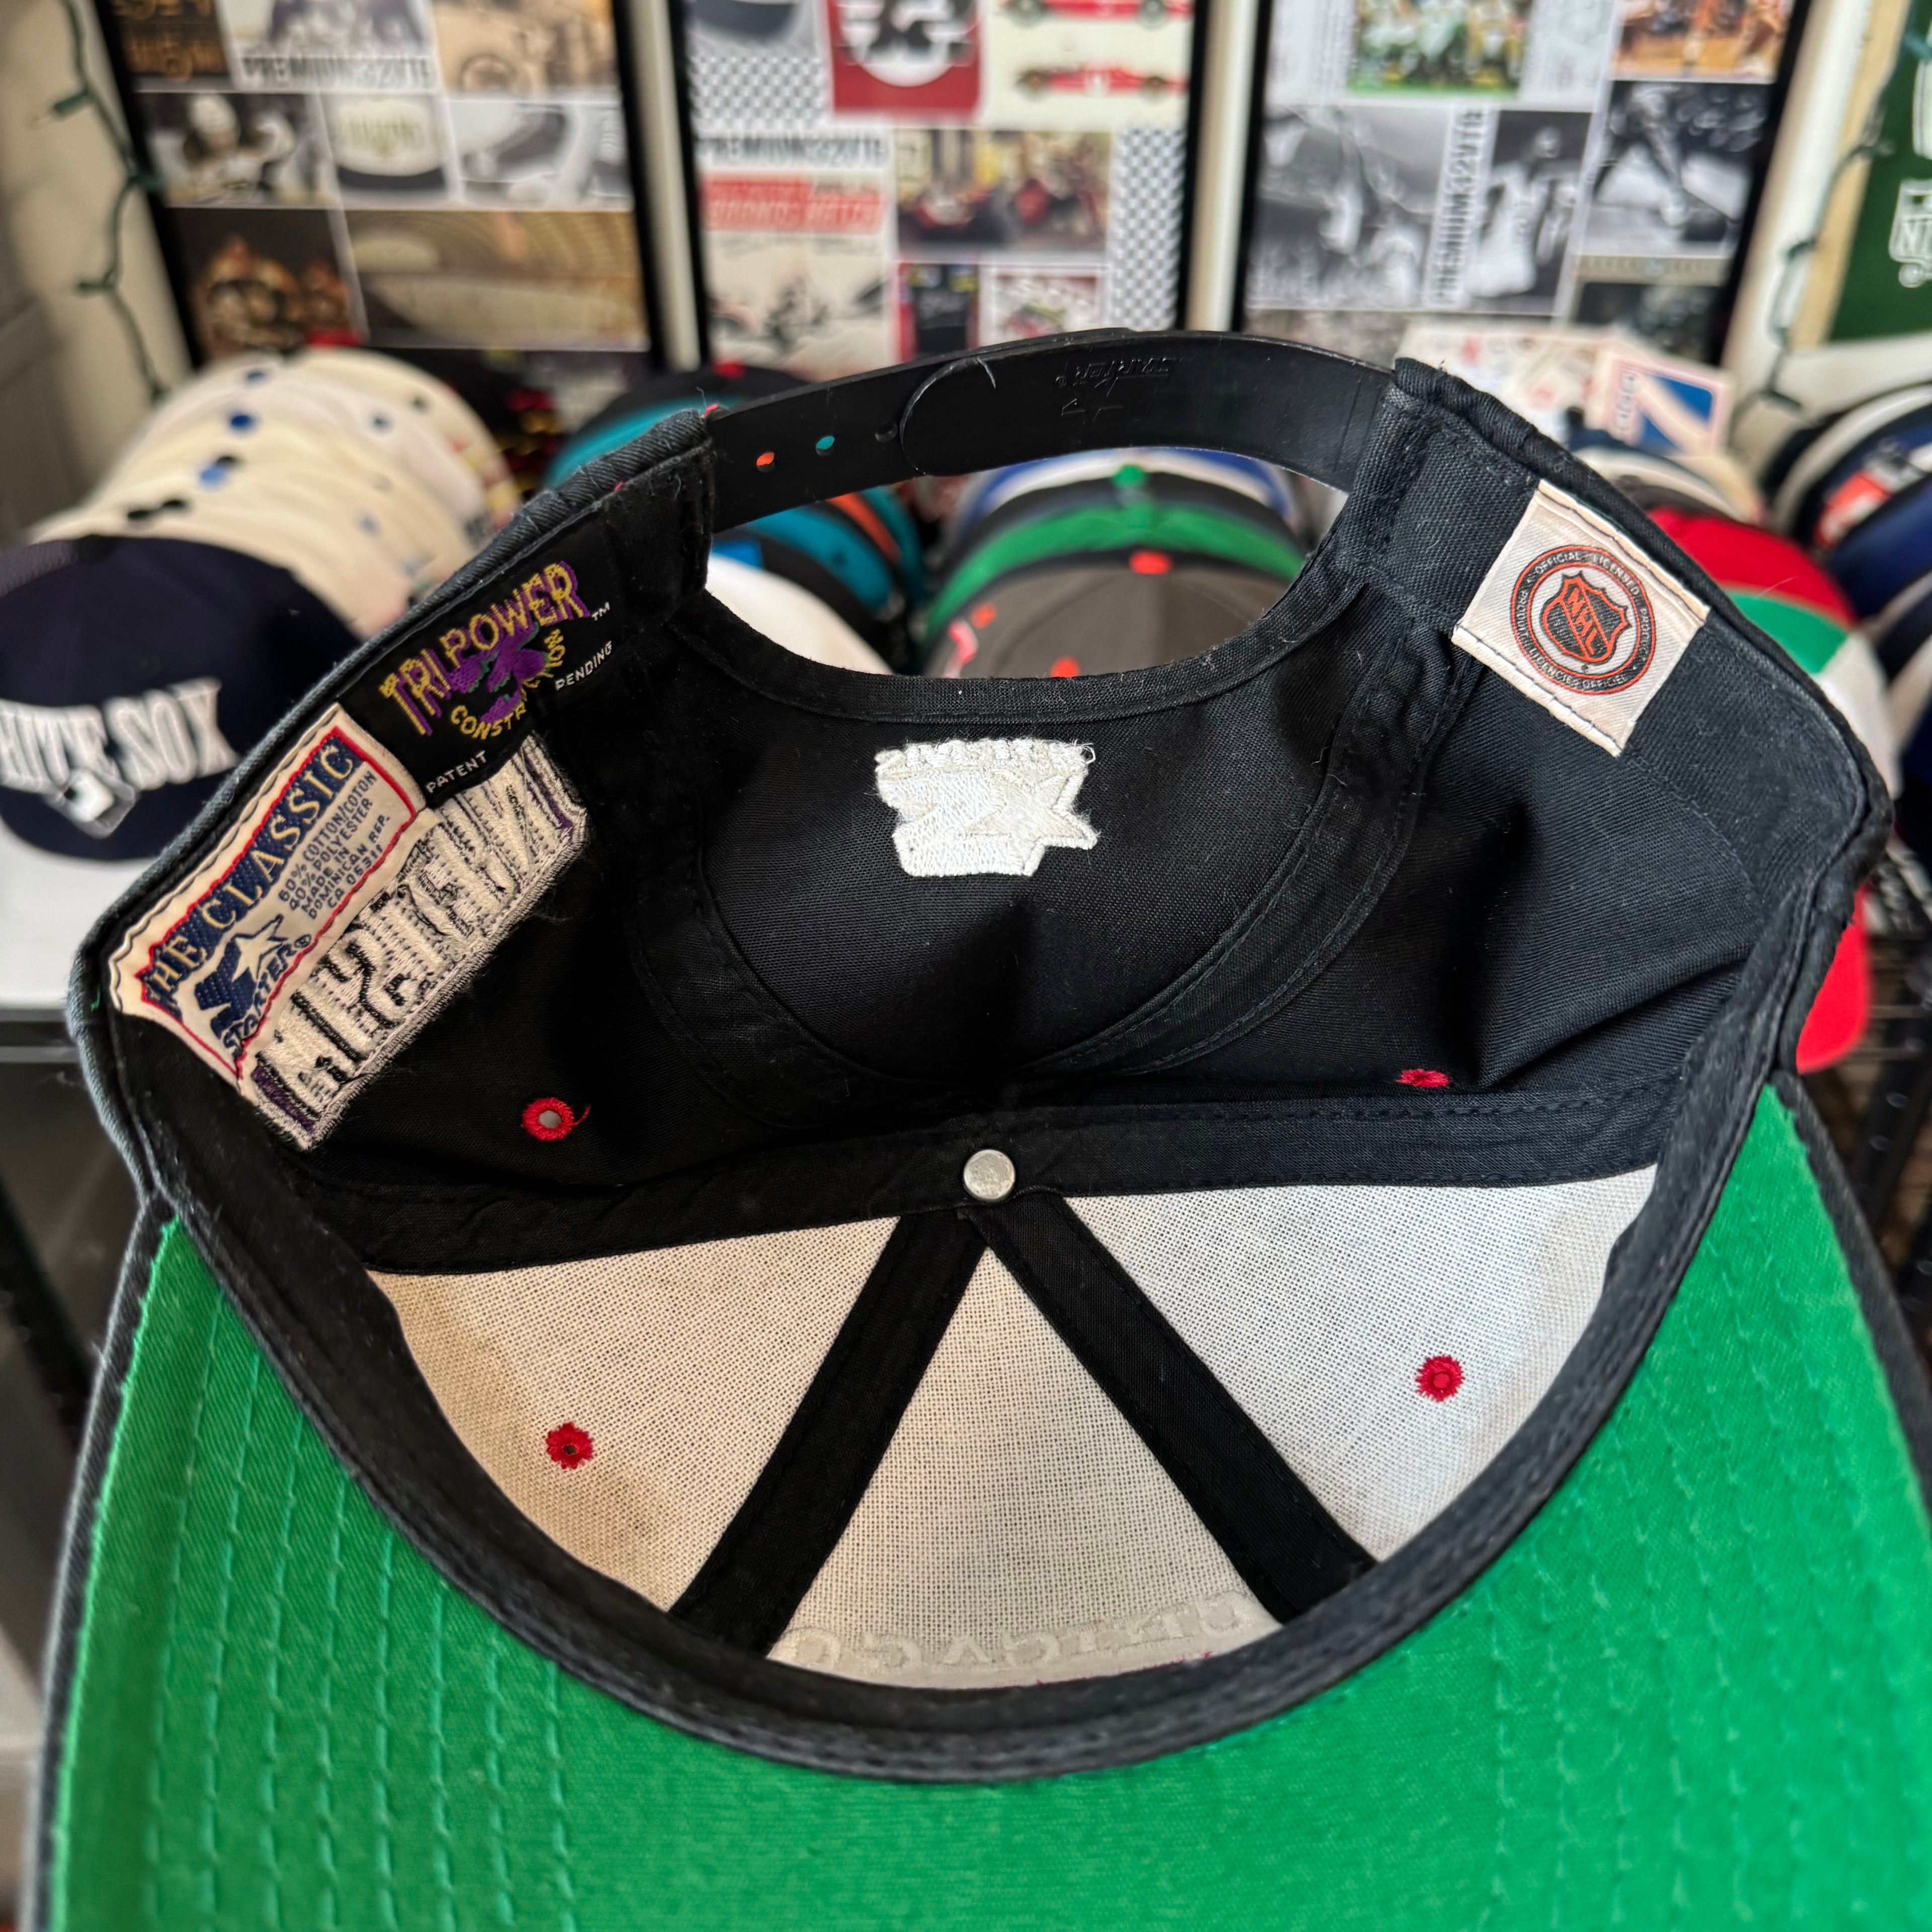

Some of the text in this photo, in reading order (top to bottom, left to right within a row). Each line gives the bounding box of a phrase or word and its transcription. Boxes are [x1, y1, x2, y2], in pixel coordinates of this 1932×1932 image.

[1535, 552, 1580, 574] OFFICIAL
[1593, 554, 1639, 595] LICENSED
[1567, 588, 1597, 656] NHL
[103, 676, 243, 791] SOX
[426, 641, 612, 794] PATENT PENDING
[202, 745, 353, 930] CLASSIC
[278, 770, 377, 902] 60% COTTON/COTON
[289, 797, 373, 911] 40% POLYESTER
[301, 846, 351, 913] MADE IN
[308, 843, 368, 920] DOMINICAN
[327, 888, 345, 908] CA
